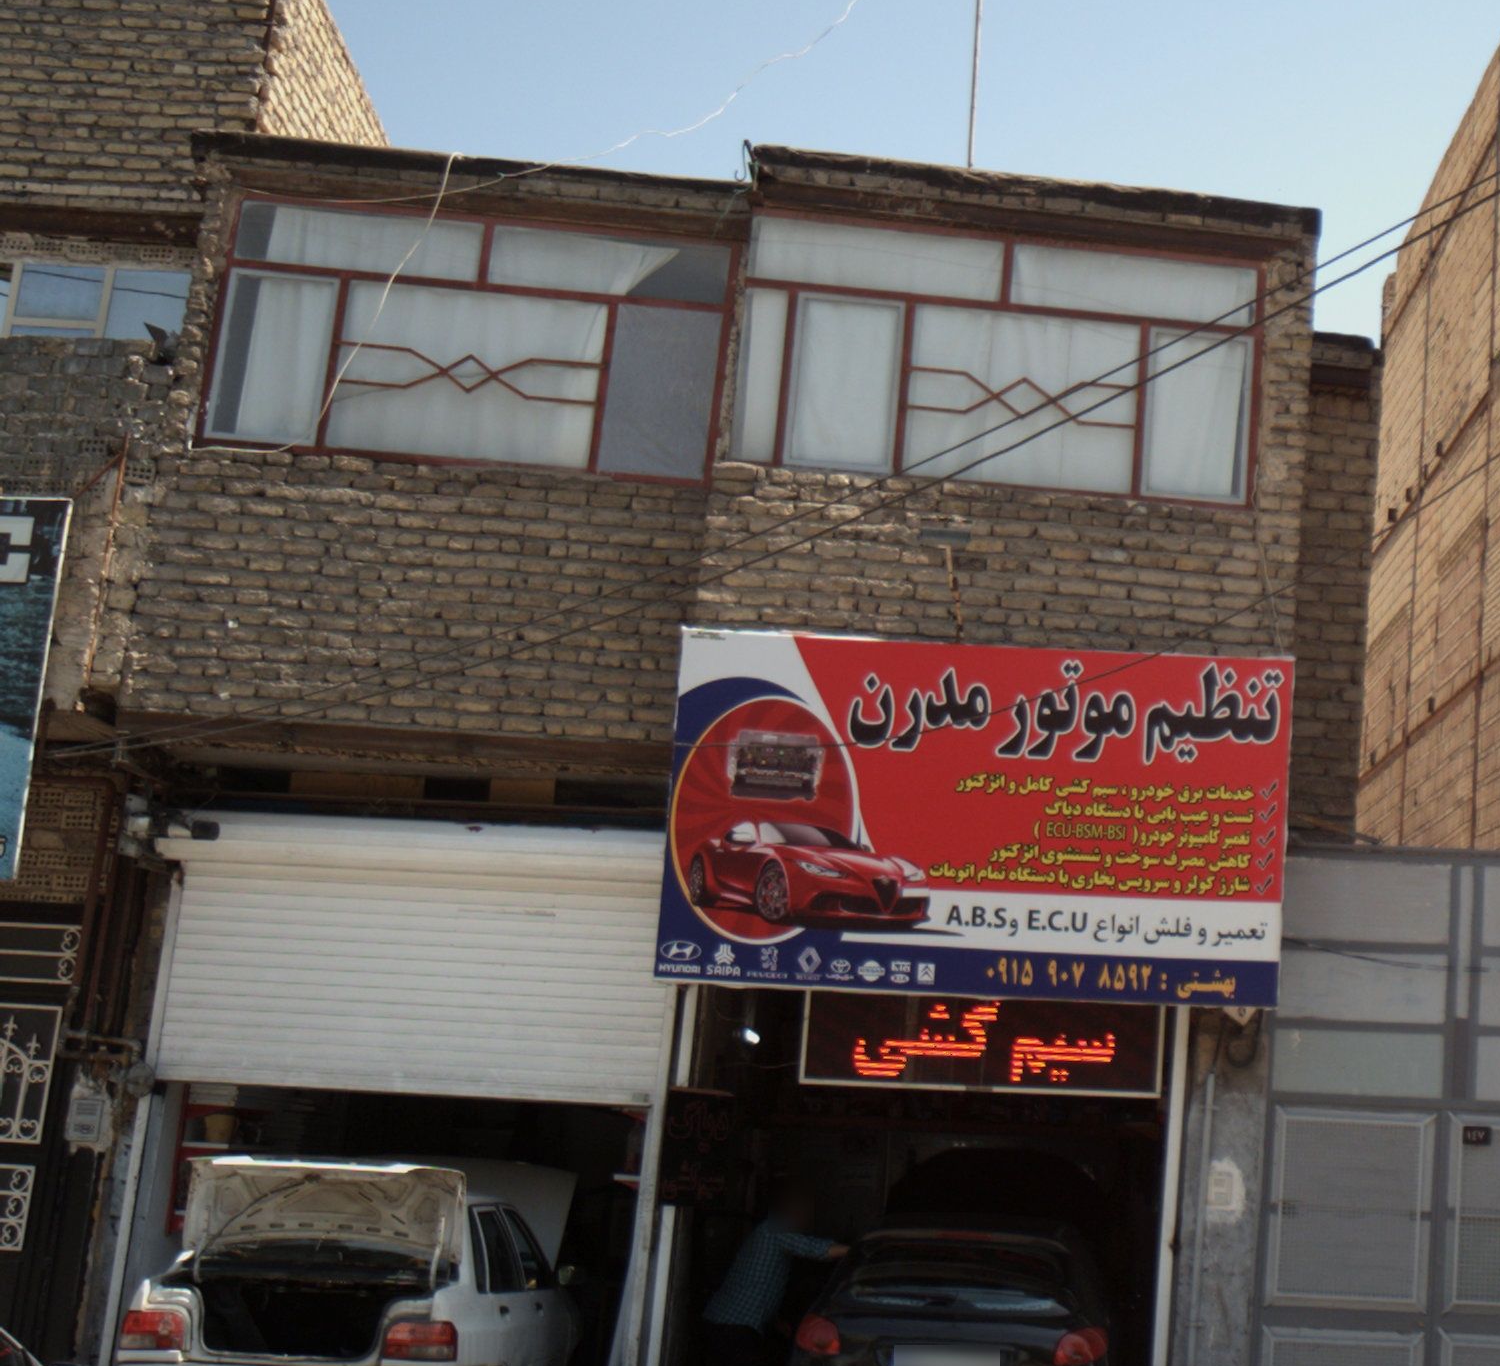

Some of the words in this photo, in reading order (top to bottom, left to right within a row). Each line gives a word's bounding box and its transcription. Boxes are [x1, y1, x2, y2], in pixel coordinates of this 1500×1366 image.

[847, 666, 991, 753] مدرن
[995, 659, 1138, 762] موتور
[1143, 661, 1285, 766] تنظیم
[1008, 782, 1016, 795] و
[1019, 776, 1053, 795] کامل
[1055, 778, 1091, 797] کشی
[1092, 786, 1118, 799] سیم
[1177, 787, 1204, 804] برق
[1206, 785, 1254, 801] خدمات
[1134, 803, 1144, 823] با
[1179, 809, 1209, 825] عیب
[1212, 813, 1220, 827] و
[1222, 808, 1254, 824] تست
[1221, 829, 1250, 849] تعمیر
[1104, 853, 1112, 868] و
[1115, 849, 1161, 870] سوخت
[1163, 850, 1206, 871] مصرف
[1208, 852, 1251, 872] کاهش
[977, 864, 1006, 883] تمام
[1059, 868, 1069, 887] با
[1071, 870, 1116, 890] بخاری
[1118, 875, 1170, 892] سرویس
[1173, 879, 1181, 893] و
[1184, 874, 1216, 895] کولر
[1218, 876, 1250, 895] شارژ
[1027, 909, 1089, 934] E.C.U
[1092, 913, 1140, 943] انواع
[1144, 916, 1193, 945] فلش
[1197, 925, 1207, 946] و
[1211, 921, 1269, 948] تعمیر
[706, 964, 741, 977] SAIPA
[853, 1000, 1001, 1078] کشی
[1010, 1033, 1116, 1083] سیم
